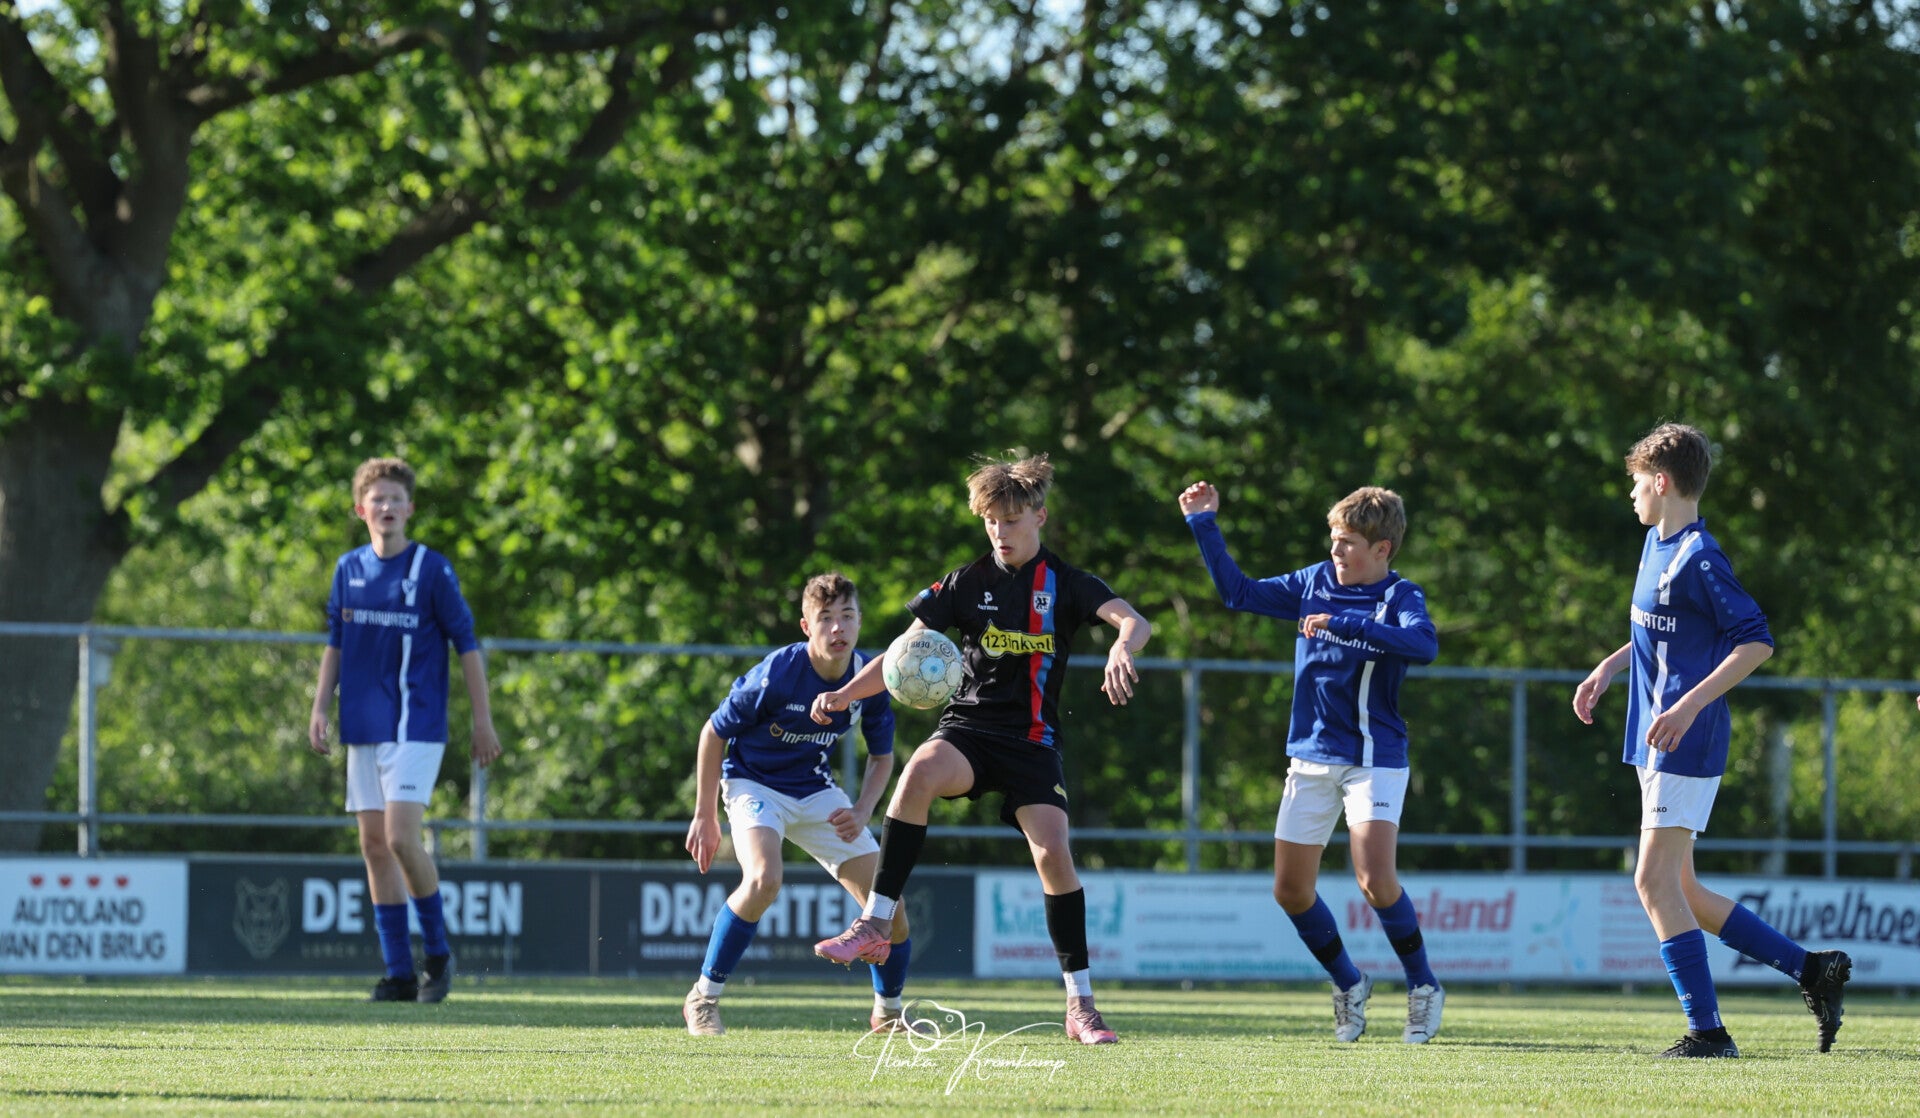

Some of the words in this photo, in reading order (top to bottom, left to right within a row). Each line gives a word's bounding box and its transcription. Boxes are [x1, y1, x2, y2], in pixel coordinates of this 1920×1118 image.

[13, 896, 145, 926] AUTOLAND
[302, 877, 366, 934] DE
[375, 879, 523, 936] REN
[46, 931, 94, 960] DEN
[99, 931, 167, 962] BRUG
